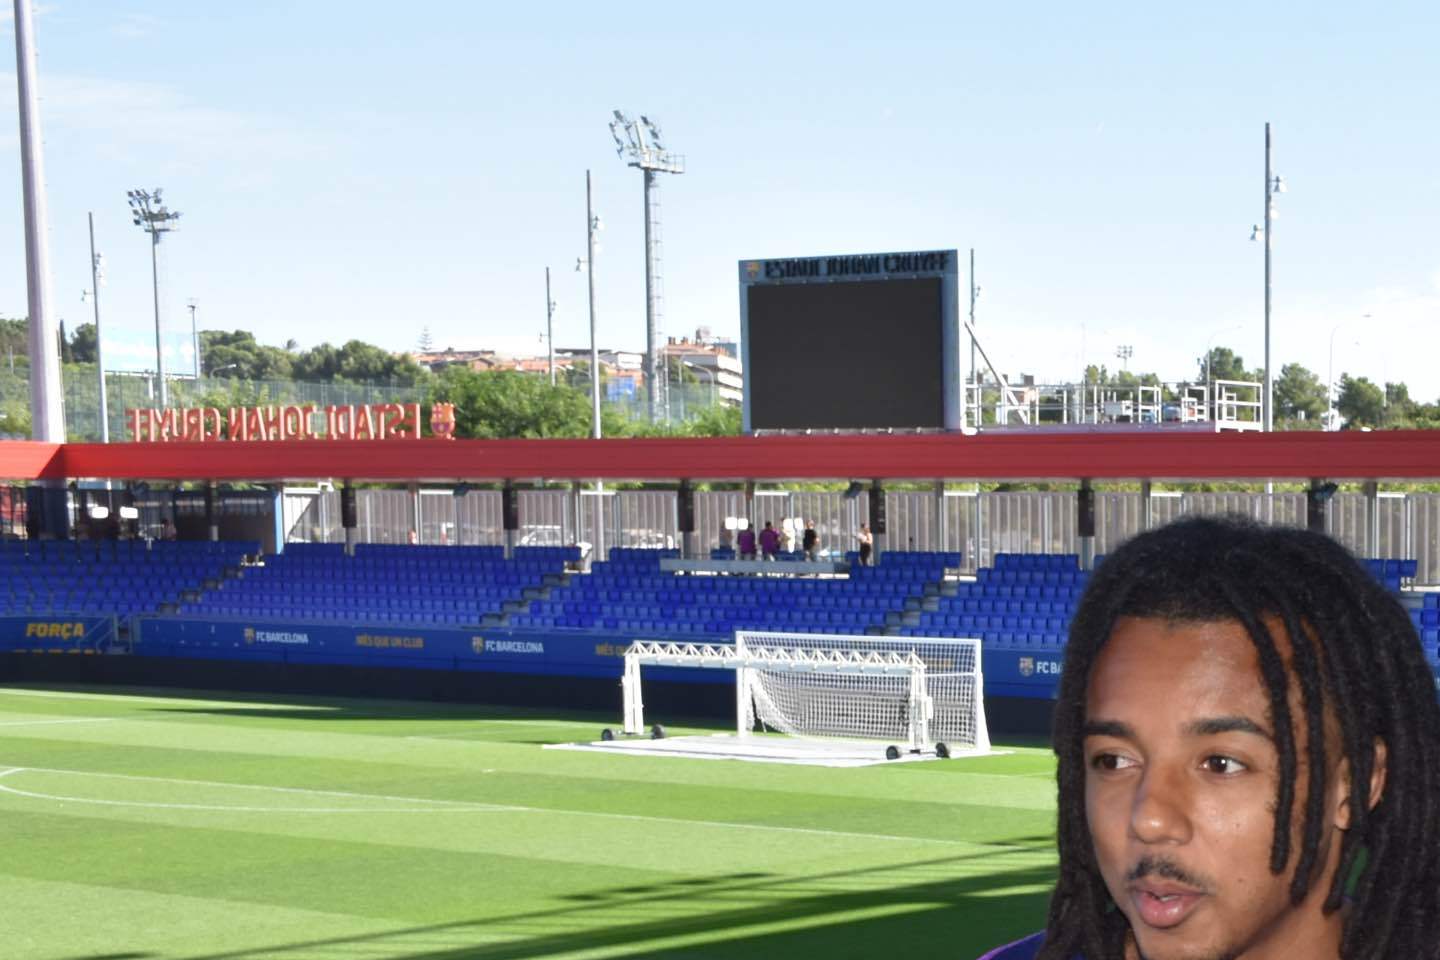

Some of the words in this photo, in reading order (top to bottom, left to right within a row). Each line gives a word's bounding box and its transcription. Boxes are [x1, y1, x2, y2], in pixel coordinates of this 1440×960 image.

[26, 622, 85, 640] FORÇA
[266, 631, 309, 645] BARCELONA
[485, 640, 495, 652] FC
[496, 641, 544, 654] BARCELONA
[1036, 661, 1049, 674] FC
